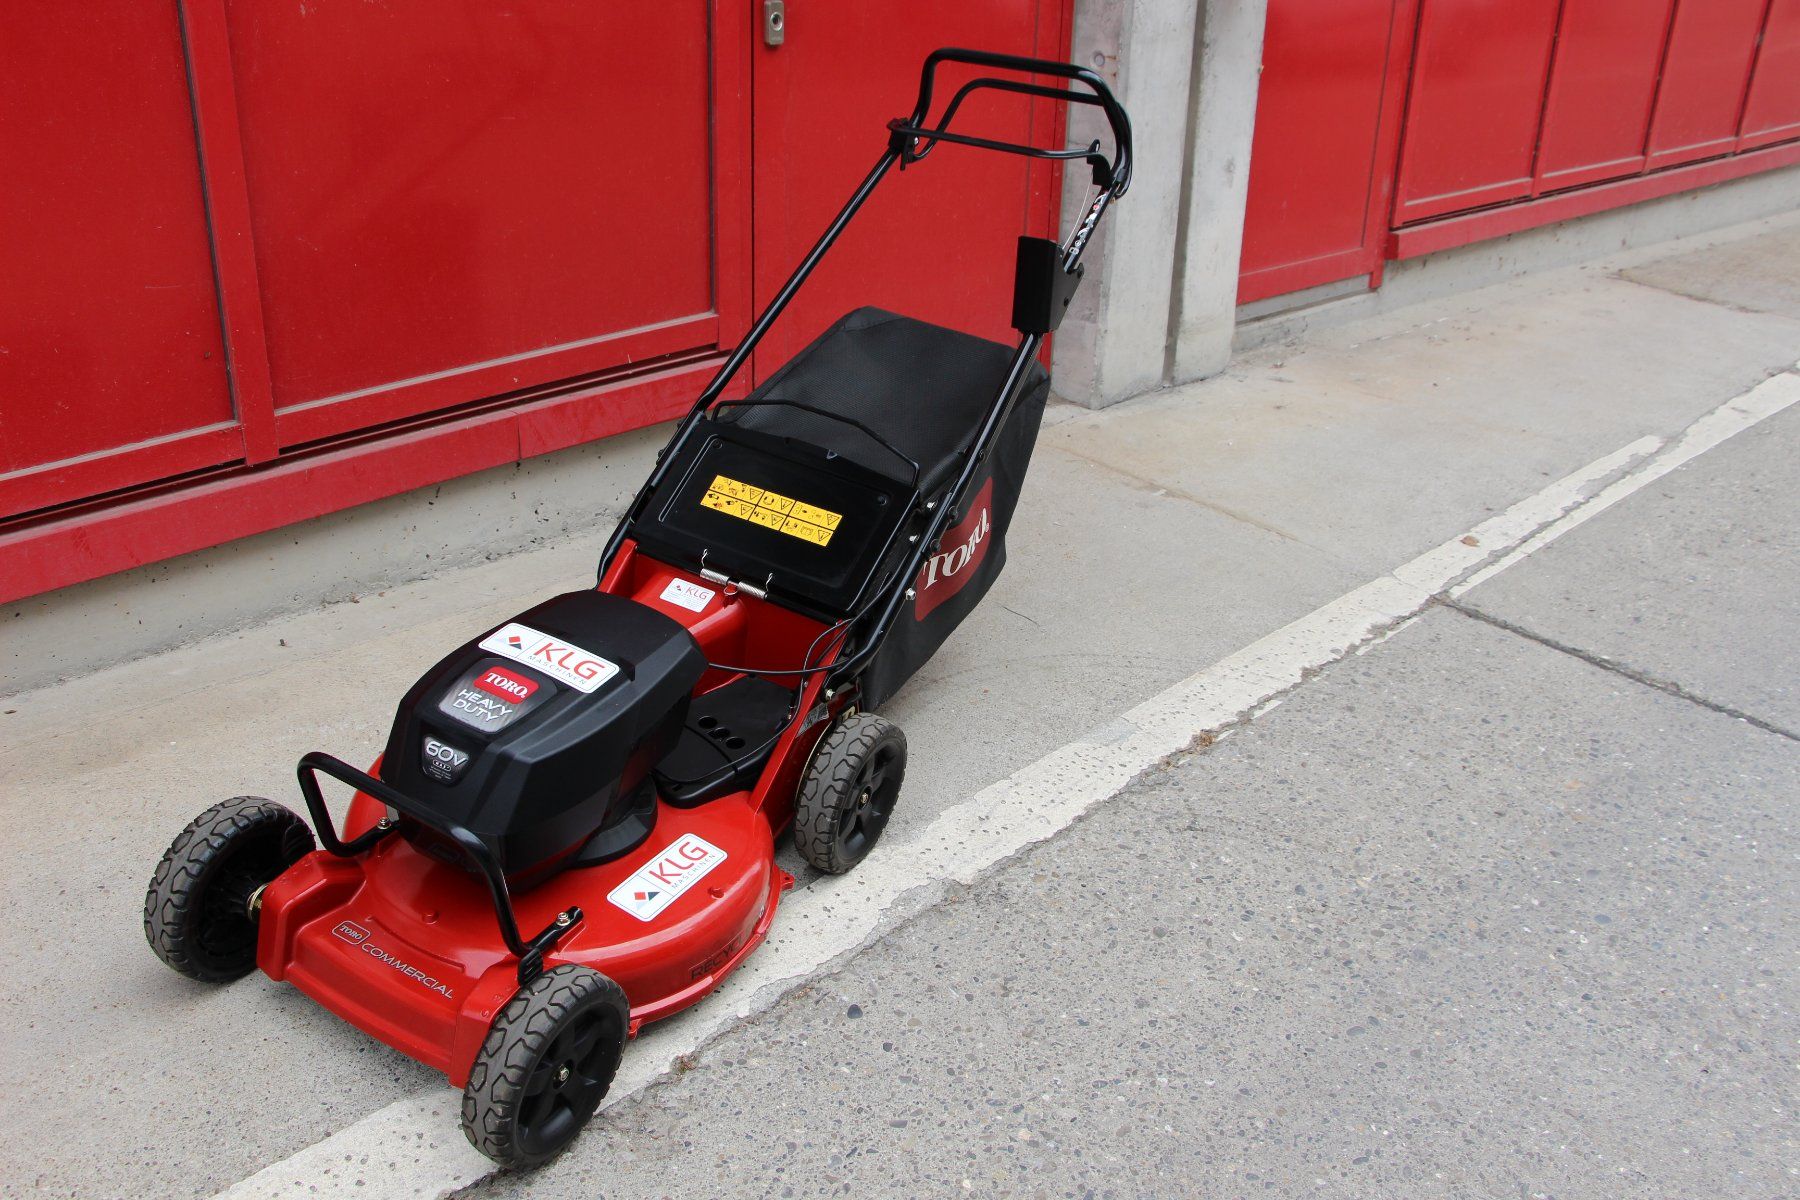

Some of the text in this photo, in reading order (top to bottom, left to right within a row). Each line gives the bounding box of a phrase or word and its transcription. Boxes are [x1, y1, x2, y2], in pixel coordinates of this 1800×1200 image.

[685, 586, 710, 600] KLG
[527, 654, 588, 685] MASCHINEN
[533, 642, 606, 680] KLG
[484, 672, 528, 697] TORO
[452, 698, 499, 722] DUTY
[458, 688, 513, 716] HEAVY
[648, 841, 709, 885] KLG
[671, 854, 716, 889] MASCHINEN
[340, 924, 454, 999] TORO COMMERCIAL
